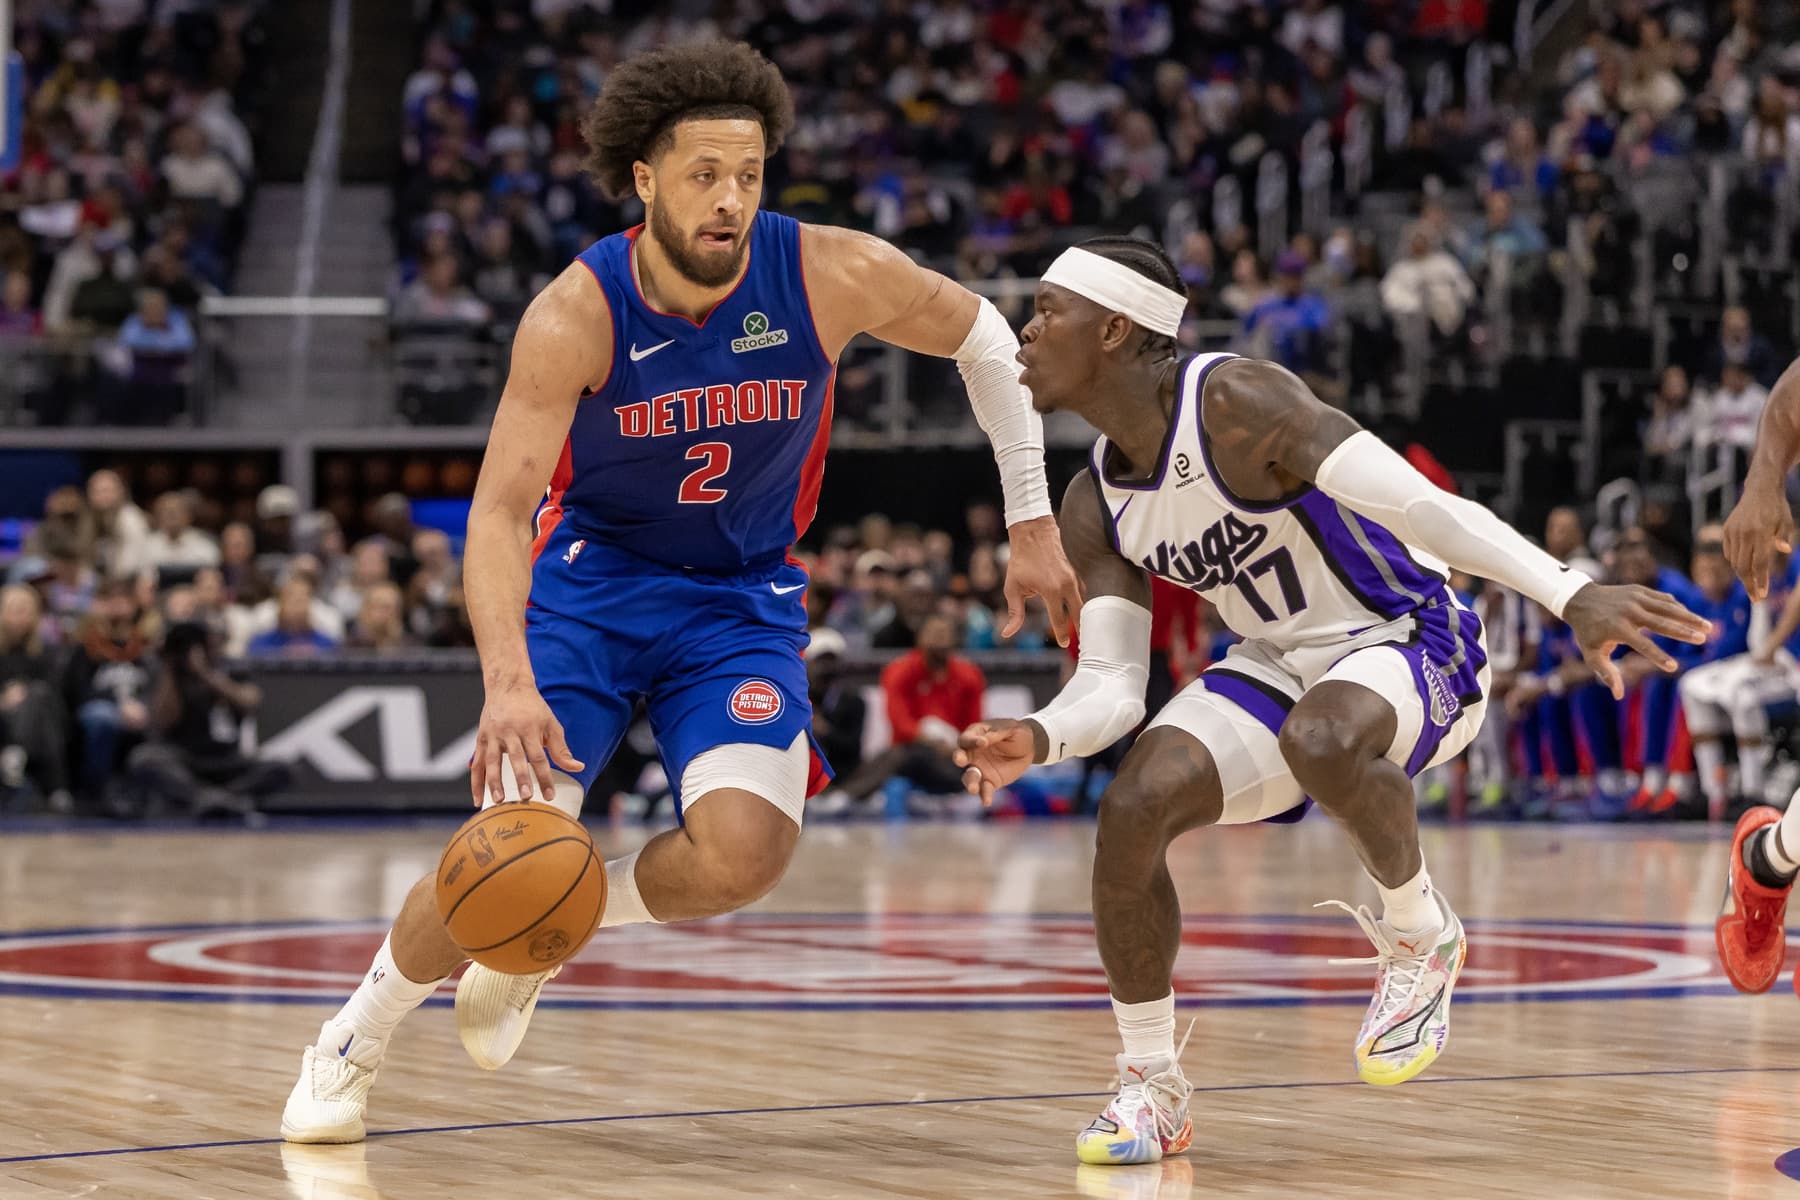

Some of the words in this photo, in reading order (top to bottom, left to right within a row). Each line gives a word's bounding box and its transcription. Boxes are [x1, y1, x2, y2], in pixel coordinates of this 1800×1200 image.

[733, 331, 786, 351] StockX
[614, 379, 807, 438] DETROIT
[678, 442, 731, 503] 2
[1142, 511, 1269, 592] Kings
[1232, 545, 1308, 623] 17
[738, 700, 774, 711] PISTONS
[740, 693, 774, 703] DETROIT
